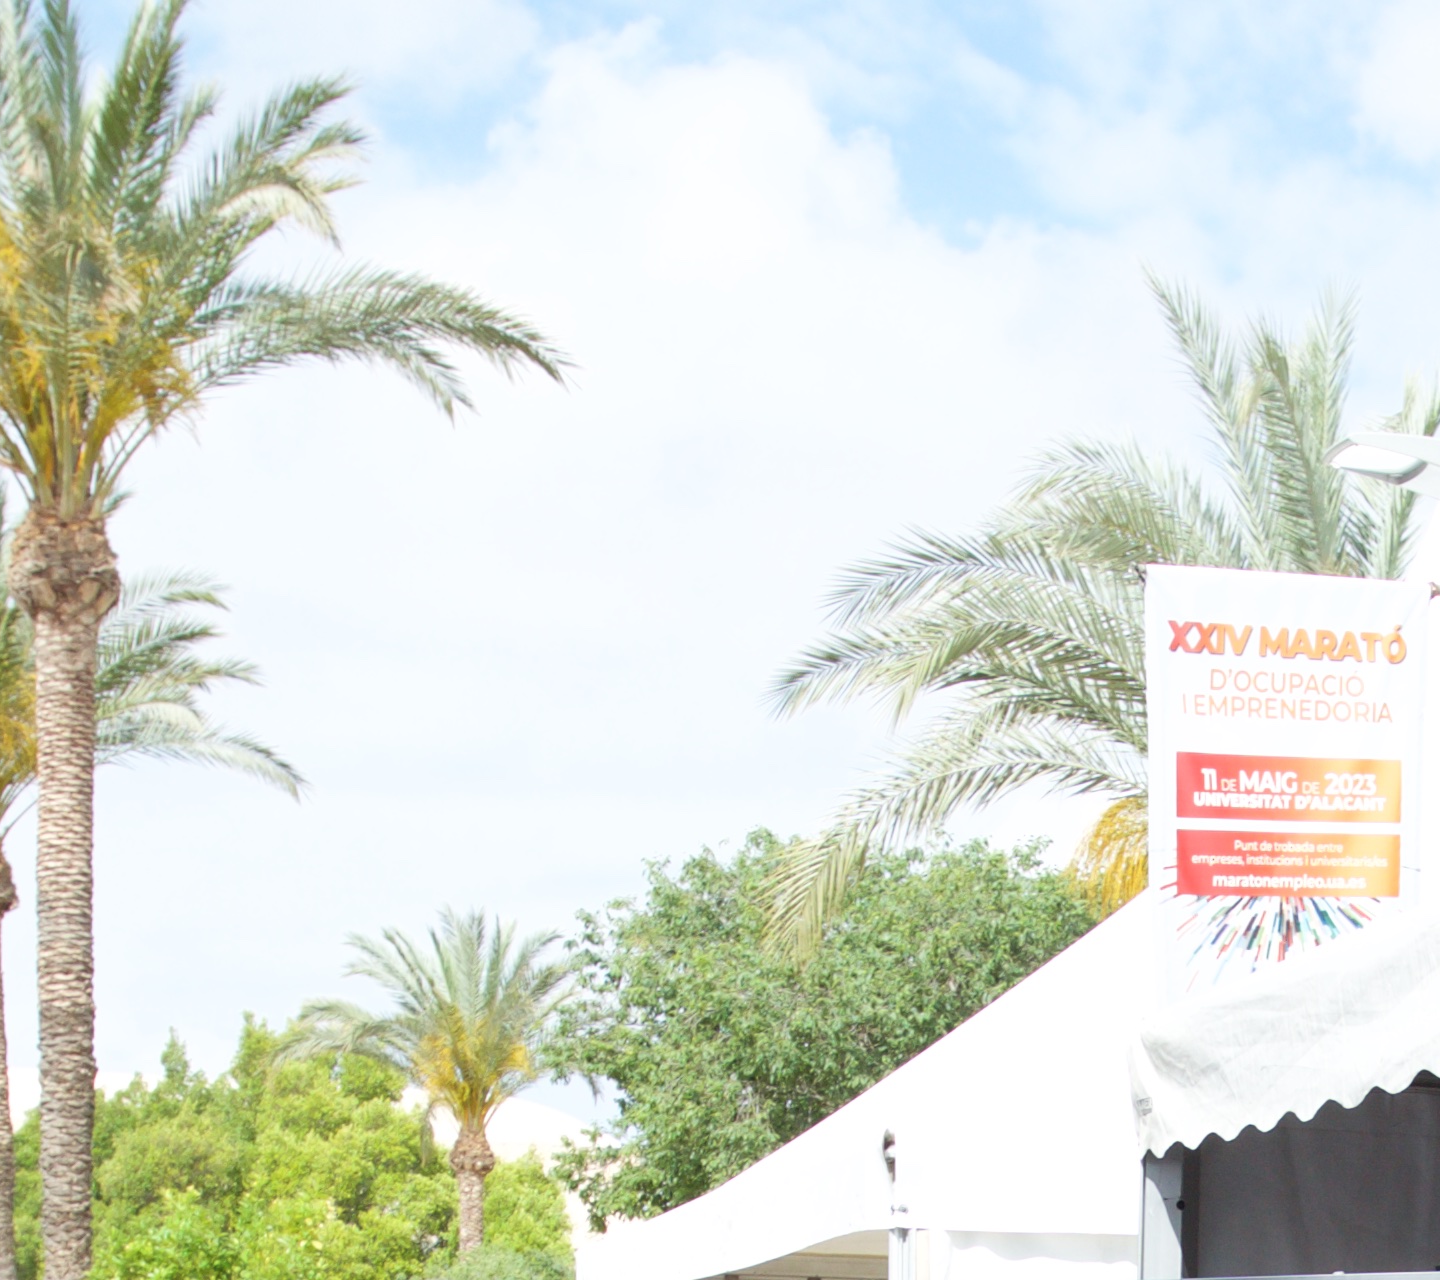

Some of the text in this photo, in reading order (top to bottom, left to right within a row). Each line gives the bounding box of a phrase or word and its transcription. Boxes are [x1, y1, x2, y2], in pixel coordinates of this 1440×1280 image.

[1168, 620, 1407, 664] XXIV MARATÓ
[1194, 694, 1392, 723] EMPRENEDORIA
[1201, 768, 1376, 795] 11 DE MAIG DE 2023
[1194, 792, 1291, 810] UNIVERSITAT
[1234, 839, 1259, 851] Punt
